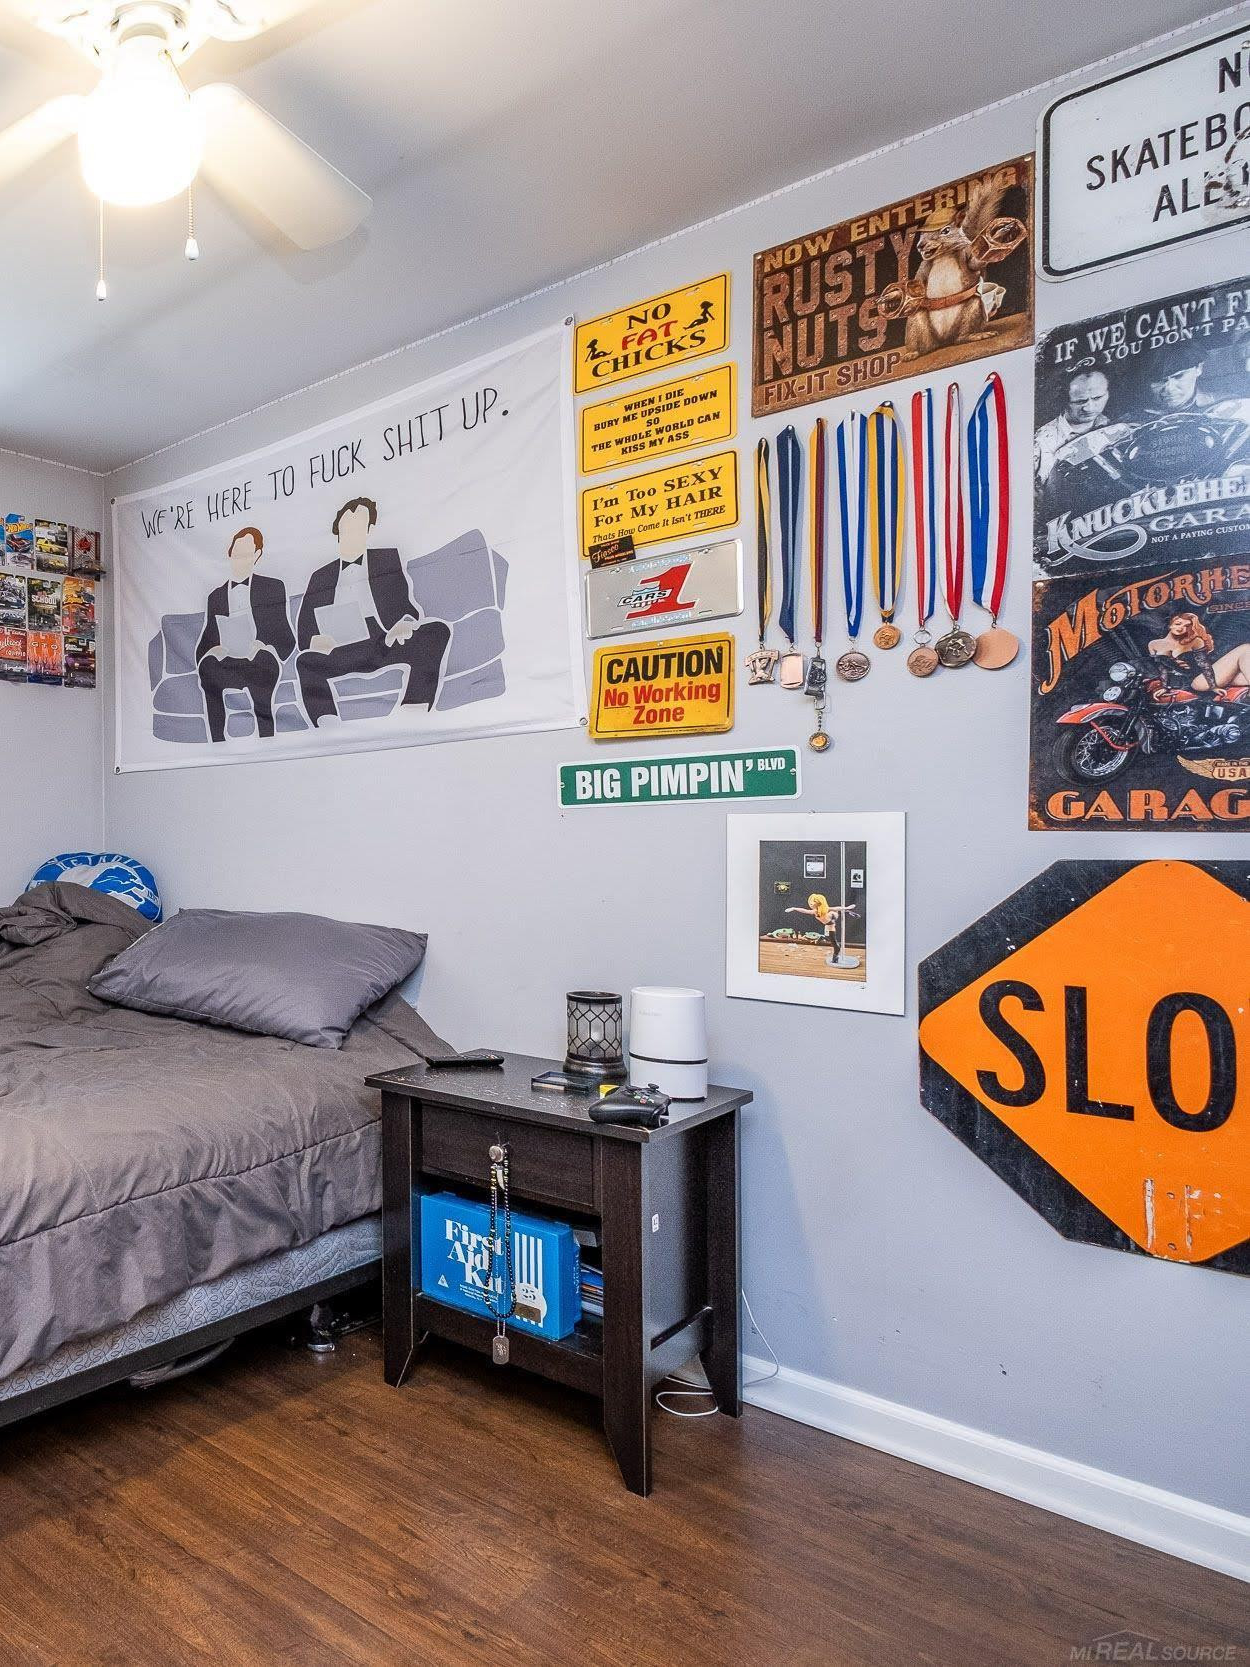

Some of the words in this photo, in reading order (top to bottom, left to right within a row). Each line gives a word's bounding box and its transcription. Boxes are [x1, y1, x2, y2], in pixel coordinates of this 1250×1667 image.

[1218, 50, 1250, 93] N
[763, 231, 835, 272] NOW
[850, 166, 1017, 242] ENTERING
[763, 225, 918, 329] RUSTY
[621, 320, 678, 350] FAT
[626, 302, 671, 330] NO
[1054, 338, 1078, 364] IF
[1088, 322, 1125, 353] WE
[1135, 297, 1216, 338] CAN'T
[592, 329, 707, 378] CHICKS
[763, 296, 888, 381] NUTS
[1104, 338, 1143, 363] YOU
[1150, 322, 1213, 349] DON'T
[1221, 315, 1250, 332] PA
[764, 369, 830, 406] FIX-IT
[836, 351, 901, 387] SHOP
[593, 416, 620, 432] BURY
[622, 412, 638, 424] ME
[640, 401, 681, 419] UPSIDE
[683, 390, 717, 407] DOWN
[624, 396, 655, 412] WHEN
[658, 393, 663, 403] I
[665, 388, 685, 402] DIE
[591, 440, 612, 453] THE
[614, 430, 652, 449] WHOLE
[655, 419, 694, 437] WORLD
[697, 411, 721, 426] CAN
[646, 417, 660, 427] SO
[621, 442, 646, 456] KISS
[648, 437, 664, 449] MY
[667, 430, 690, 444] ASS
[141, 501, 195, 539] WE'RE
[207, 481, 252, 523] HERE
[268, 466, 295, 500] TO
[309, 439, 366, 488] FUCK
[383, 404, 449, 461] SHIT
[461, 388, 509, 430] UP.
[592, 497, 619, 512] I'm
[625, 486, 657, 503] Too
[663, 466, 724, 493] SEXY
[593, 512, 623, 528] For
[630, 503, 658, 519] My
[665, 485, 723, 510] HAIR
[592, 532, 616, 544] Thats
[618, 527, 635, 537] How
[637, 521, 660, 532] Come
[662, 518, 669, 527] It
[671, 512, 692, 524] Isn't
[694, 505, 726, 520] THERE
[1151, 535, 1169, 544] NOT
[1181, 529, 1213, 539] PAYING
[622, 590, 667, 604] CARS
[606, 646, 724, 685] CAUTION
[603, 688, 629, 708] No
[633, 680, 721, 705] Working
[632, 705, 685, 725] Zone
[575, 770, 622, 800] BIG
[631, 758, 754, 797] PIMPIN'
[757, 757, 786, 772] BLVD
[1218, 768, 1247, 778] USA
[976, 980, 1237, 1133] SLO
[444, 1219, 504, 1256] First
[447, 1240, 490, 1271] Aid
[464, 1262, 503, 1295] Kit
